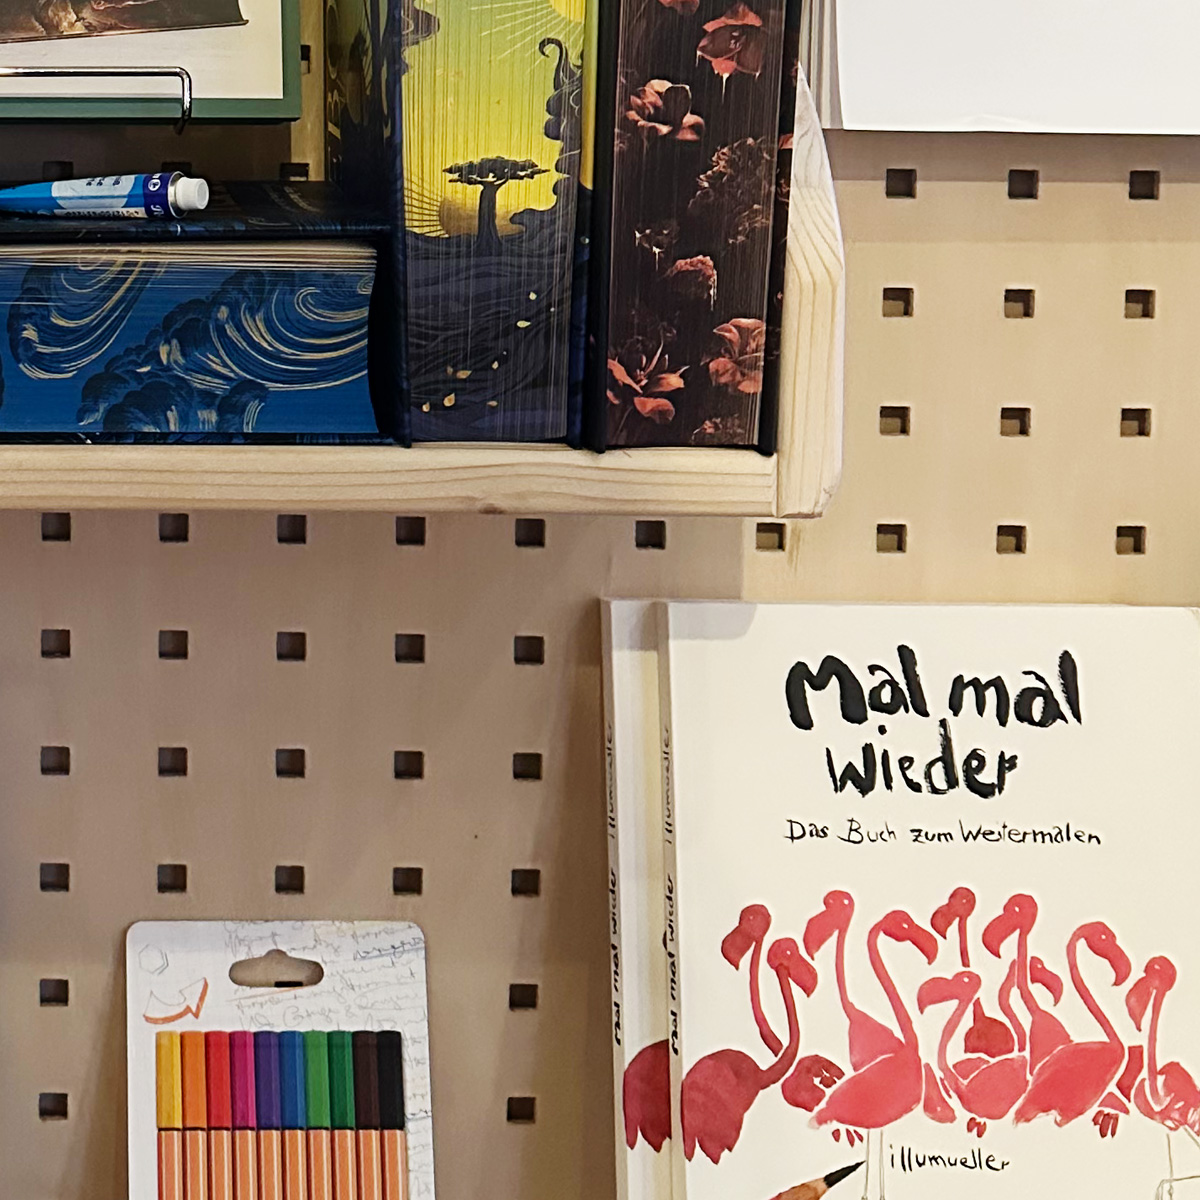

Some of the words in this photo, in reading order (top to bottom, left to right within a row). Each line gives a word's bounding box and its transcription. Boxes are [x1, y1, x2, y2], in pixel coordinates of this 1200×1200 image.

[785, 644, 931, 731] Mal
[948, 649, 1083, 728] mal
[783, 818, 829, 843] Das
[836, 817, 897, 844] Buch
[908, 828, 954, 843] zum
[958, 819, 1102, 845] Weitermalen
[611, 943, 620, 993] mal
[667, 951, 677, 1001] mal
[889, 1145, 1010, 1173] illumueller
